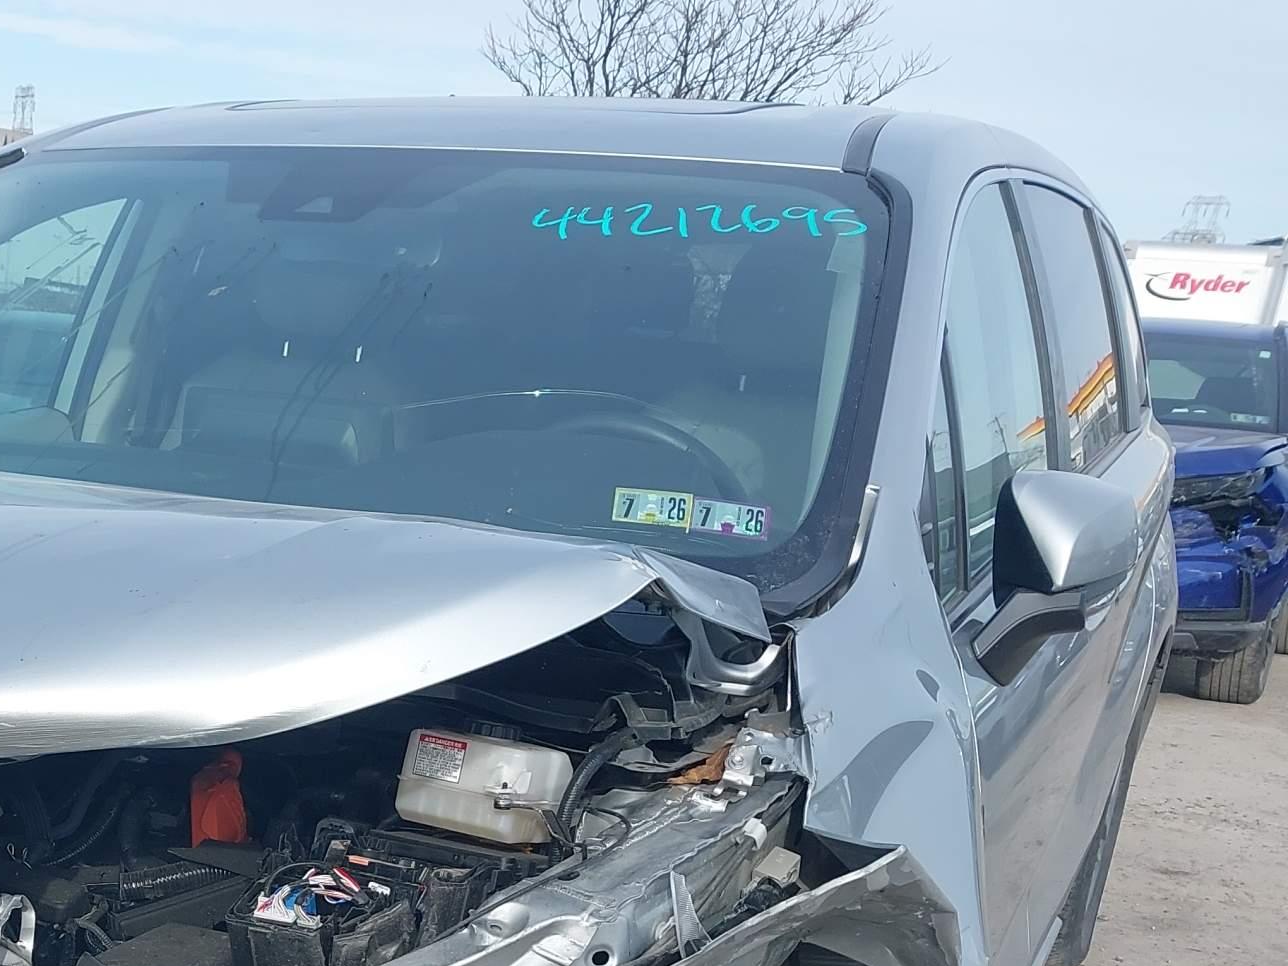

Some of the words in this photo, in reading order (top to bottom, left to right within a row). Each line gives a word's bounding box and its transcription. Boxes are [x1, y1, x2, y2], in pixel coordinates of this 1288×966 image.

[531, 203, 868, 240] 44212695
[1168, 272, 1250, 295] Ryder
[622, 498, 634, 518] 7
[667, 497, 687, 521] 26
[700, 506, 712, 527] 7
[745, 508, 764, 533] 26
